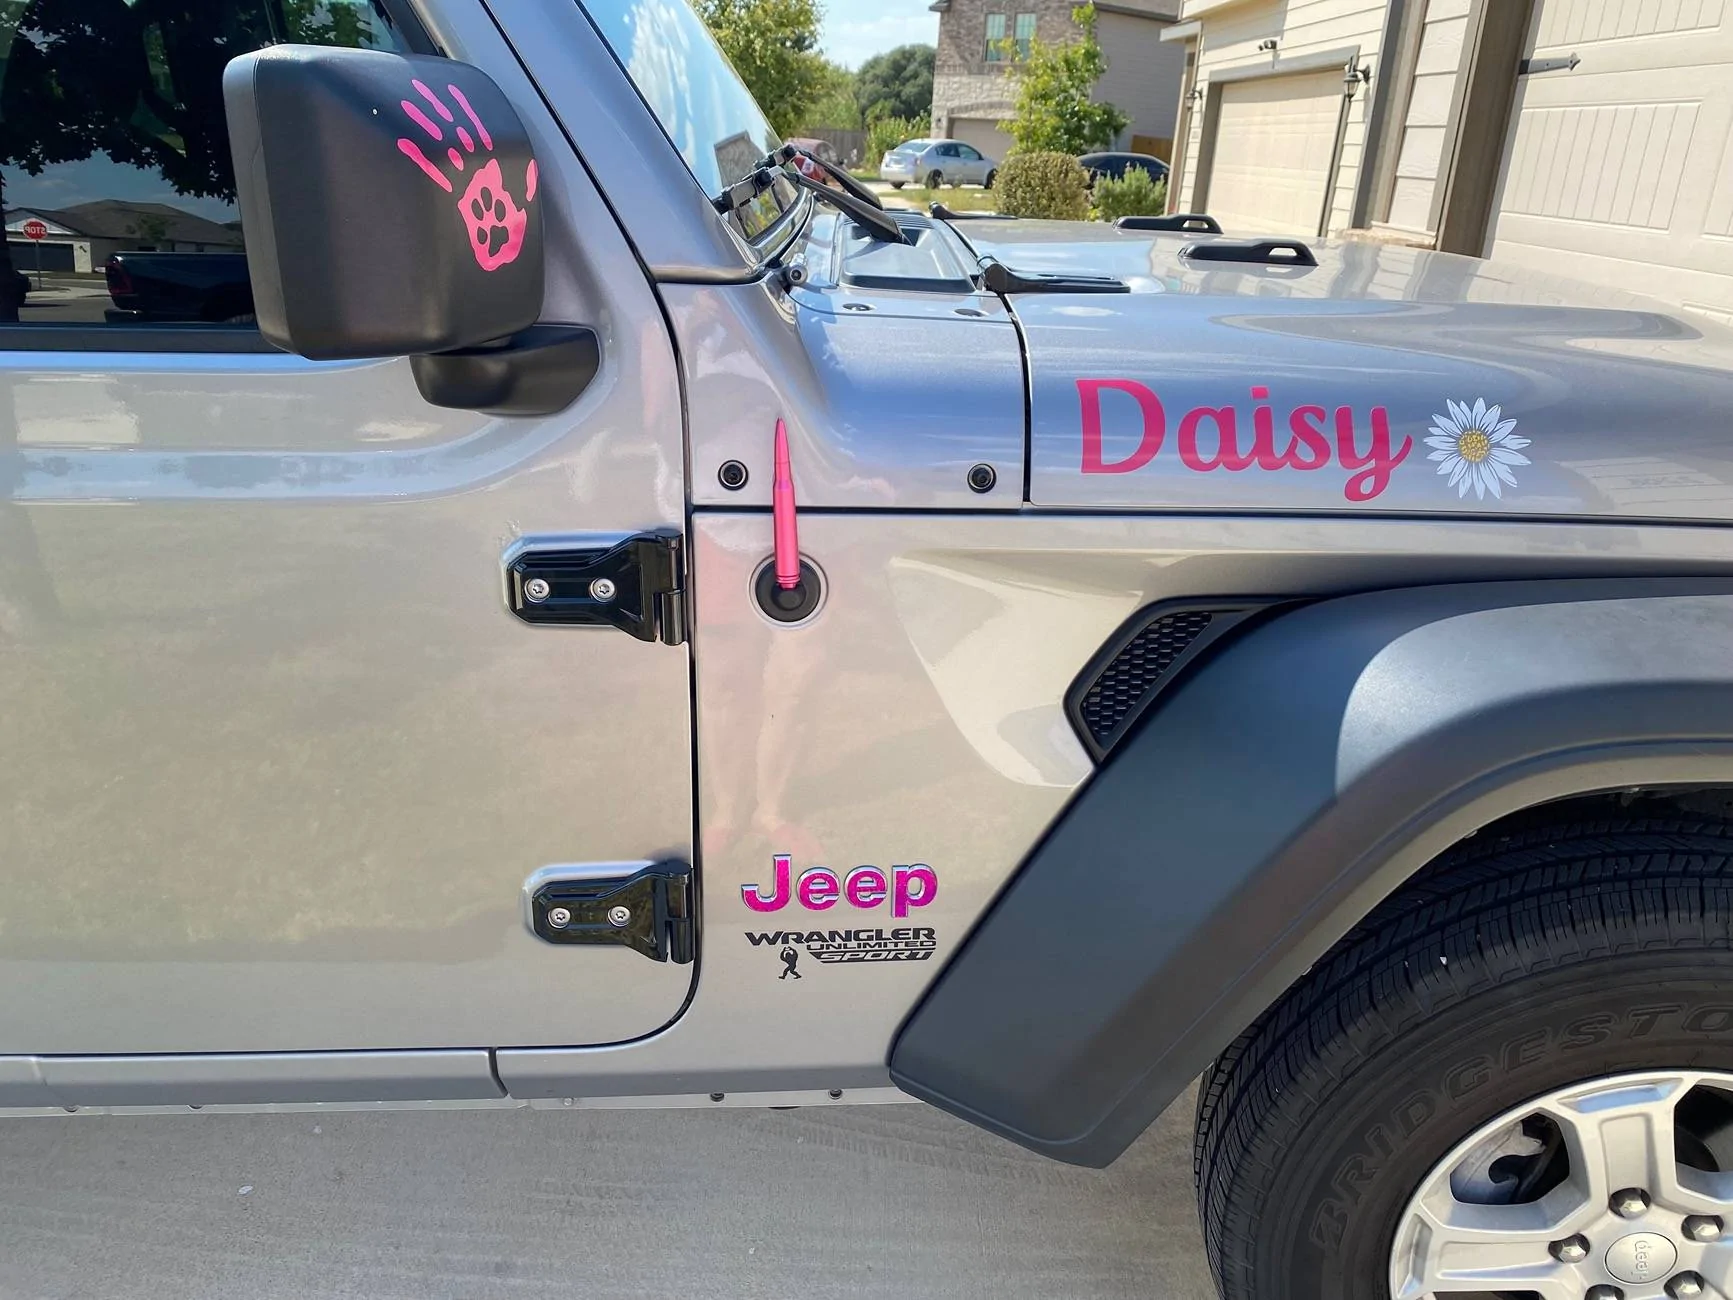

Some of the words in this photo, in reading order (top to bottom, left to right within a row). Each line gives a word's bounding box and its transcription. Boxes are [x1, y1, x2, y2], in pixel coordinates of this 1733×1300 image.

[1075, 378, 1413, 502] Daisy
[741, 854, 938, 918] Jeep
[744, 927, 936, 946] WRANGLER
[806, 940, 937, 951] UNLIMITED
[817, 950, 934, 961] SPORT
[1631, 1240, 1653, 1280] Jeep
